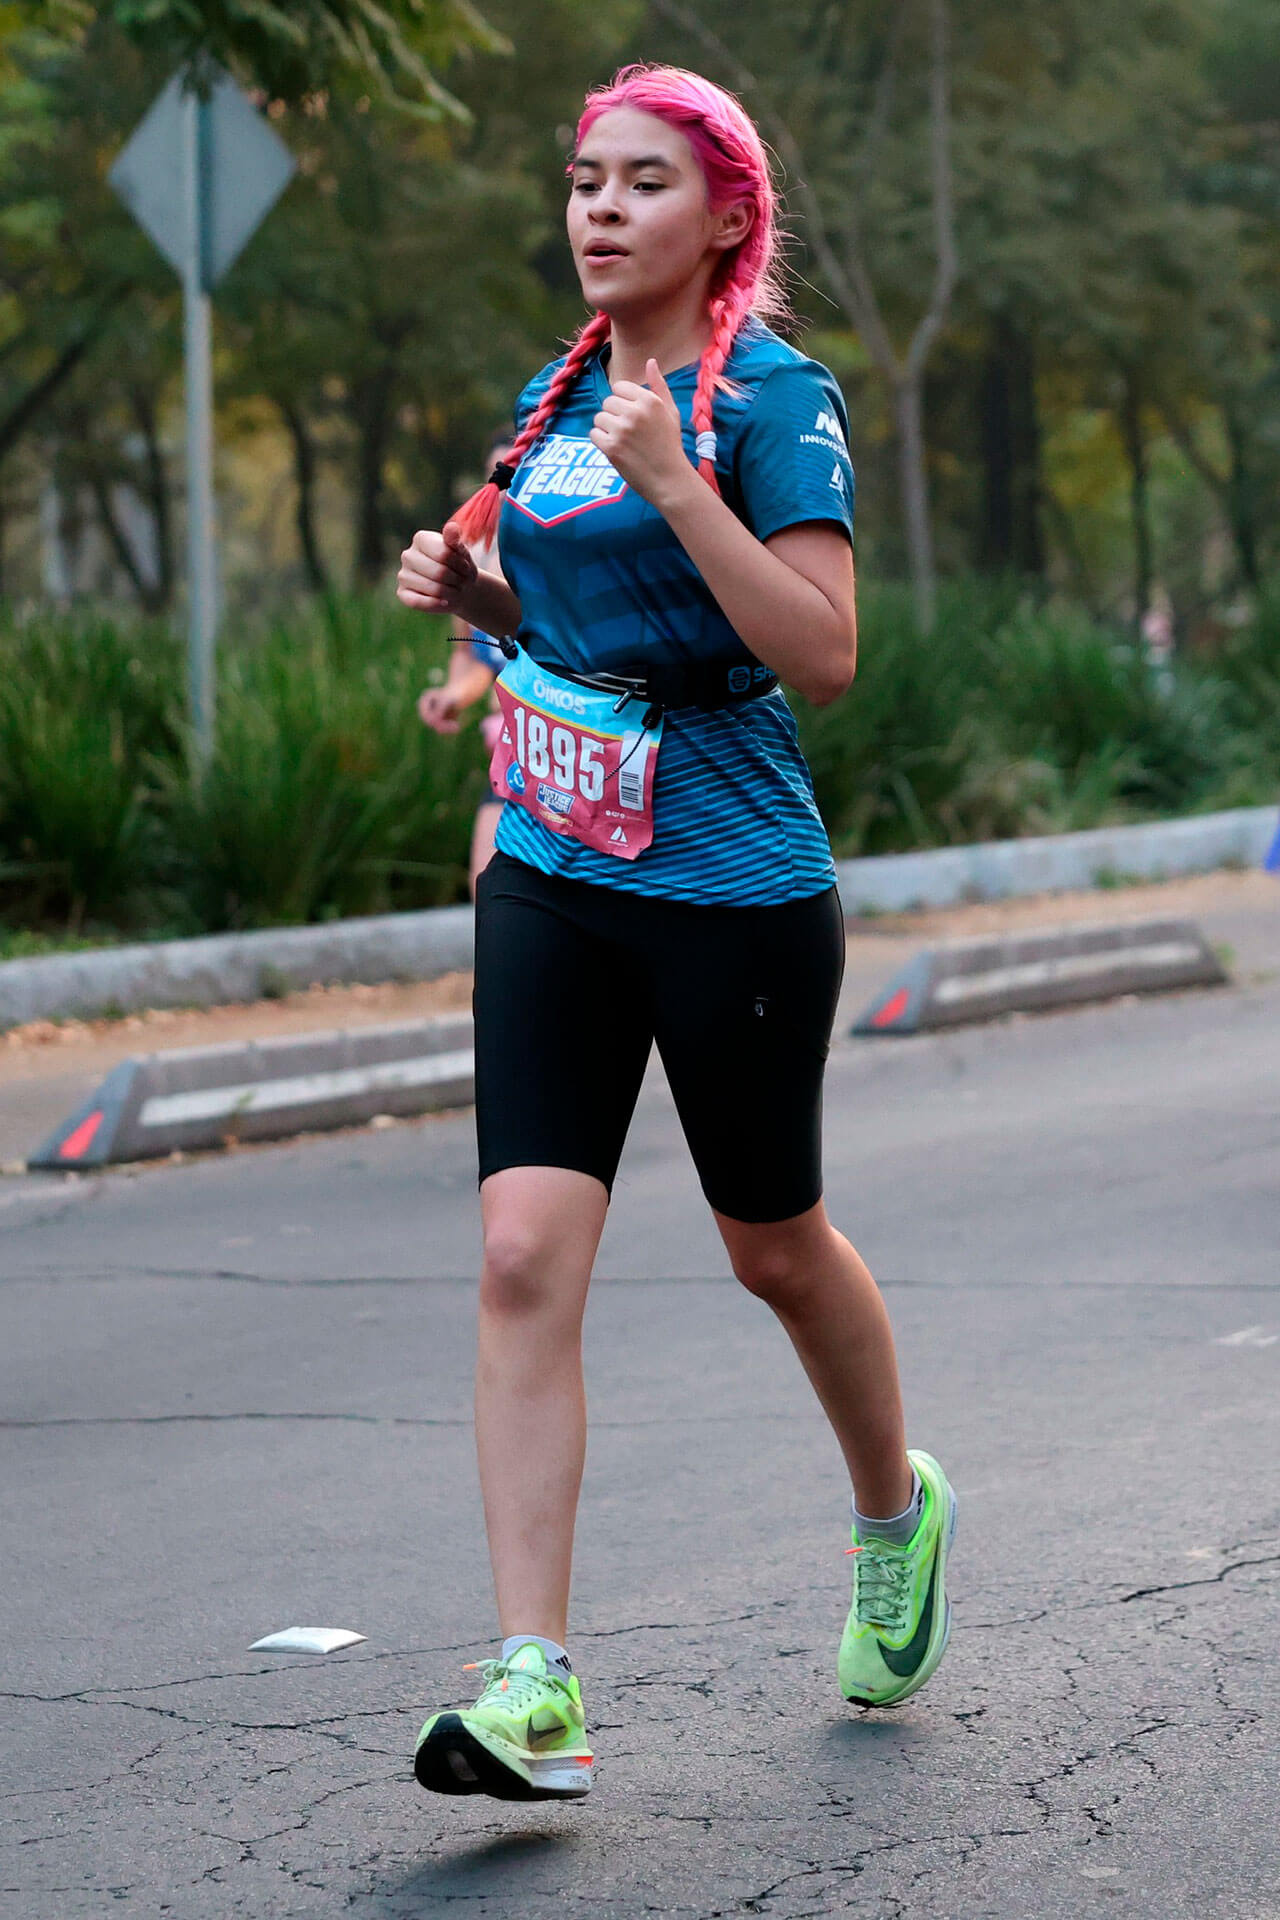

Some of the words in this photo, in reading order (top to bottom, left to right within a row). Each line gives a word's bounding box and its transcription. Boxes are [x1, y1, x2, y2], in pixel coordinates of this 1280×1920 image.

[522, 436, 613, 468] JUSTIC
[516, 467, 620, 504] LEAGUE
[513, 706, 605, 802] 1895
